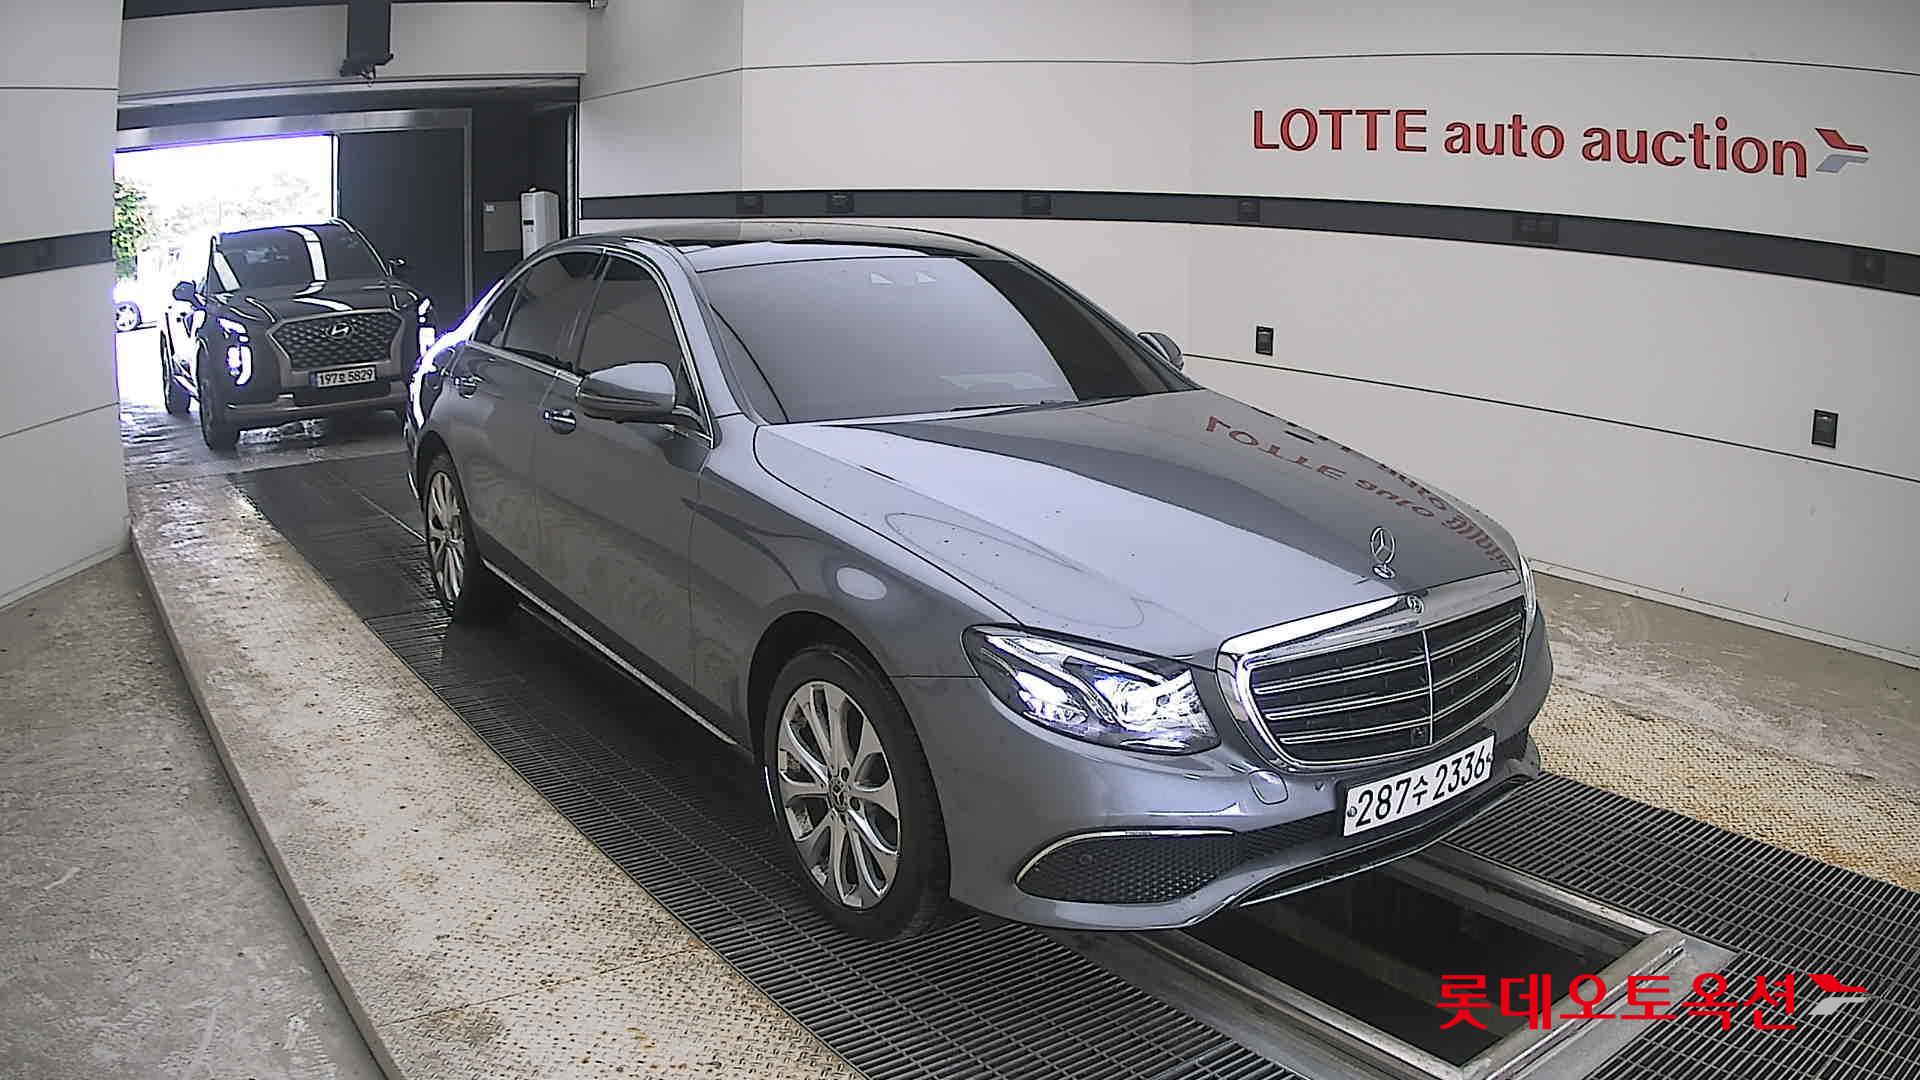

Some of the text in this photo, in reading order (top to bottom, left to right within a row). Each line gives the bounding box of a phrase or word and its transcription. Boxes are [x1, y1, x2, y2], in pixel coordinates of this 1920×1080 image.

[1253, 108, 1809, 179] LOTTE auto auction
[347, 369, 373, 382] 5829
[1355, 745, 1486, 828] 287수 2336
